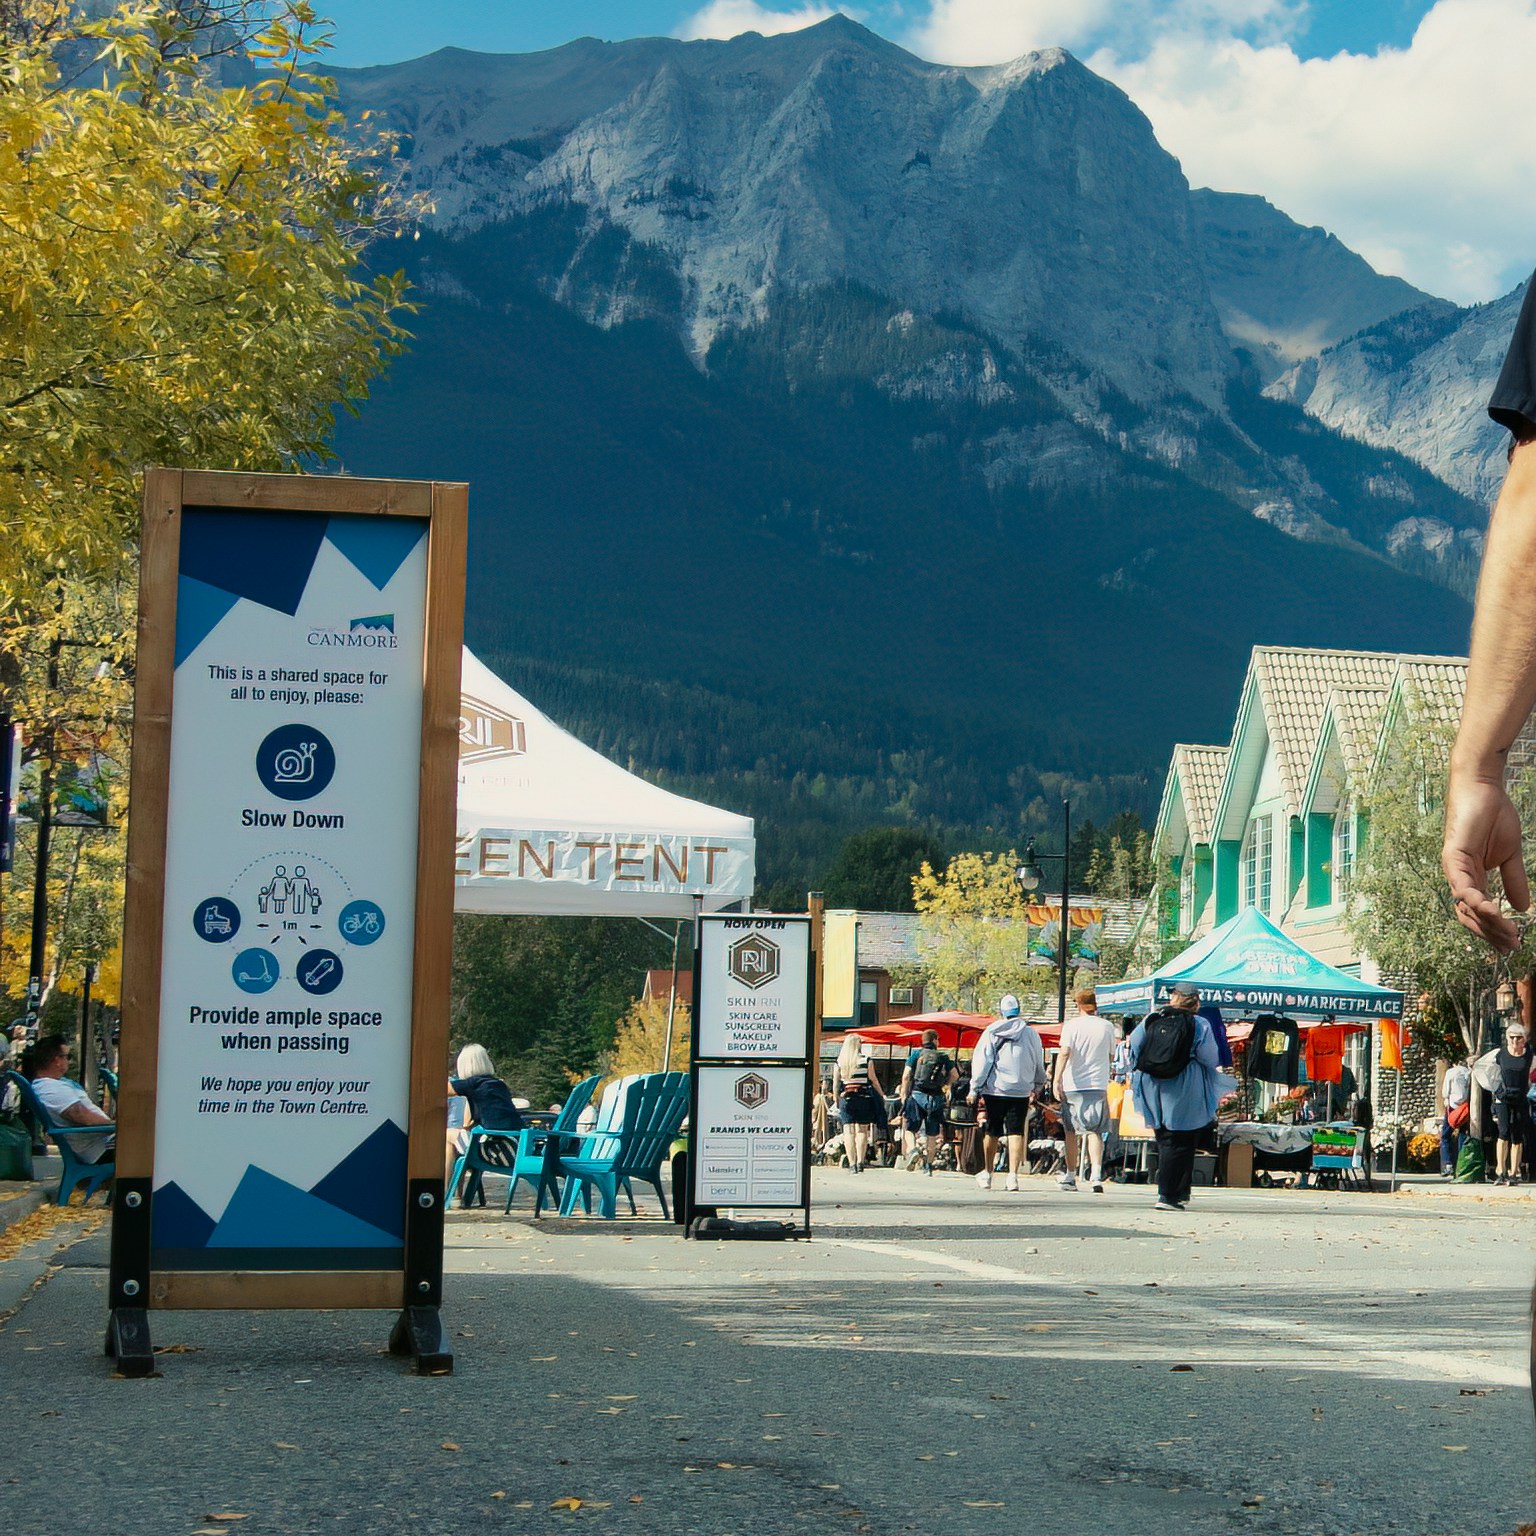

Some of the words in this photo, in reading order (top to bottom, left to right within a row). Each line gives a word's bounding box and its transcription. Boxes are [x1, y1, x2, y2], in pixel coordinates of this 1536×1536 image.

[307, 632, 398, 648] CANMORE
[208, 665, 237, 680] This
[242, 666, 253, 680] is
[258, 670, 266, 681] a
[271, 668, 319, 683] shared
[324, 671, 364, 686] space
[370, 670, 388, 685] for
[230, 686, 247, 700] all
[252, 688, 265, 701] to
[270, 688, 310, 705] enjoy,
[314, 689, 364, 705] please:
[242, 809, 286, 827] Slow
[293, 810, 344, 829] Down
[576, 842, 728, 885] TENT
[282, 921, 298, 930] 1m
[724, 920, 752, 929] NOW
[755, 921, 786, 929] OPEN
[727, 998, 756, 1006] SKIN
[1247, 992, 1283, 1006] OWN
[1296, 994, 1400, 1014] MARKETPLACE
[190, 1006, 259, 1025] Provide
[266, 1008, 321, 1028] ample
[328, 1012, 382, 1029] space
[729, 1012, 751, 1020] SKIN
[753, 1012, 777, 1020] CARE
[221, 1032, 271, 1050] when
[278, 1033, 350, 1054] passing
[733, 1033, 773, 1041] MAKEUP
[727, 1043, 757, 1051] BROW
[200, 1076, 222, 1092] We
[226, 1077, 262, 1094] hope
[265, 1079, 292, 1094] you
[296, 1078, 334, 1095] enjoy
[337, 1081, 371, 1095] your
[198, 1099, 230, 1113] time
[234, 1099, 247, 1113] in
[252, 1099, 274, 1113] the
[279, 1100, 315, 1113] Town
[320, 1100, 369, 1114] Centre.
